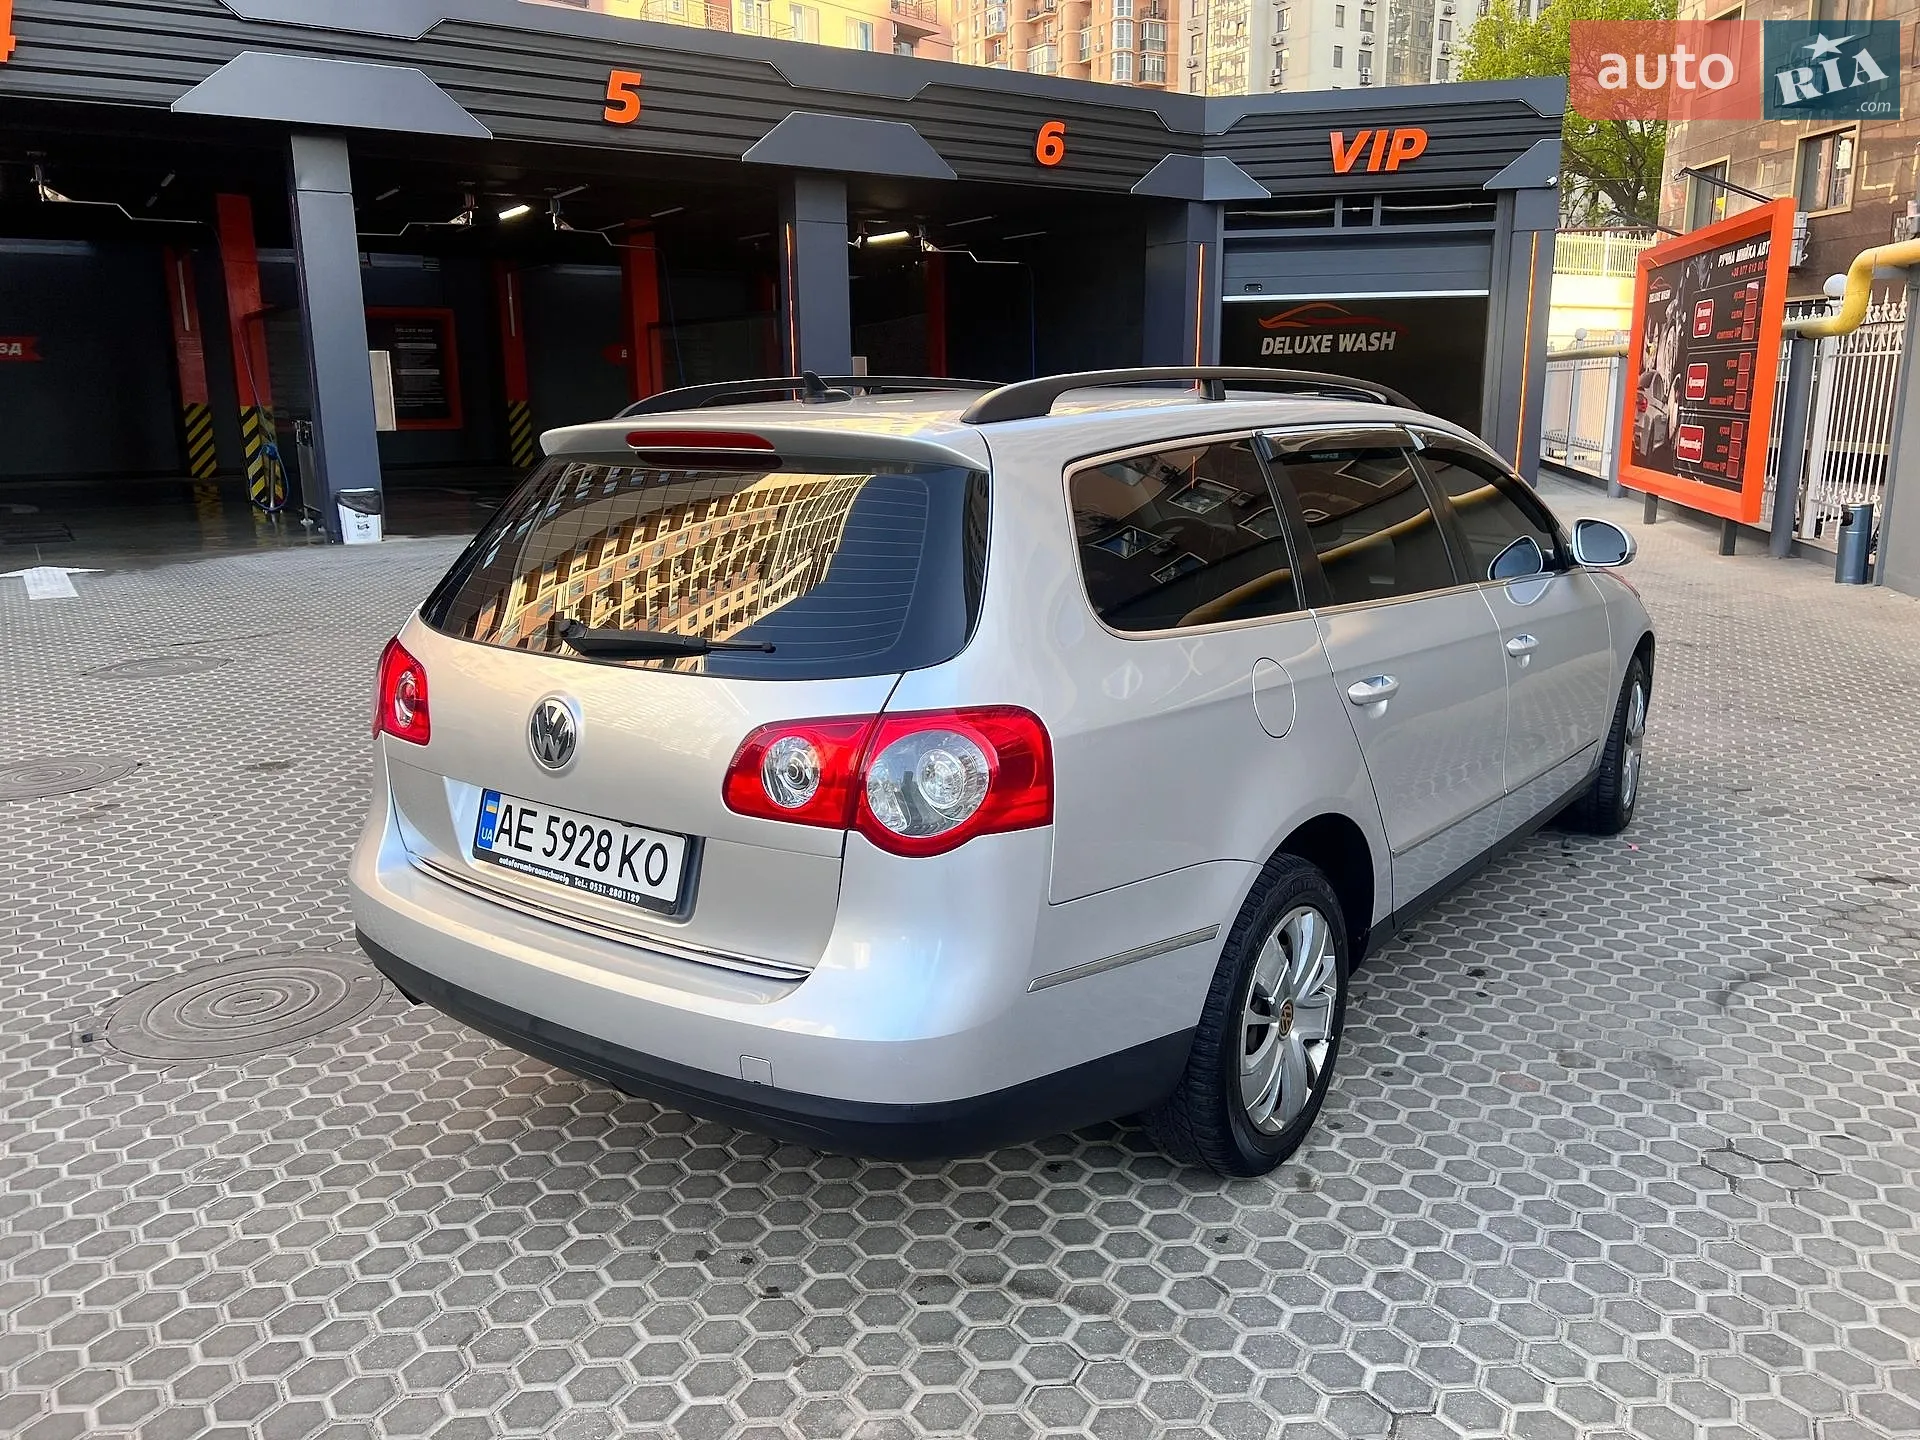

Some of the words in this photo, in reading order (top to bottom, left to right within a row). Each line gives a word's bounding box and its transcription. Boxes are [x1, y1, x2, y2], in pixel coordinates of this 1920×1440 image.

[604, 70, 642, 124] 5
[1036, 121, 1065, 166] 6
[1330, 128, 1429, 173] VIP
[1261, 334, 1333, 355] DELUXE
[1338, 331, 1396, 352] WASH
[481, 827, 493, 842] UA
[495, 804, 537, 852] AE
[541, 815, 613, 872] 5928
[618, 834, 668, 887] KO
